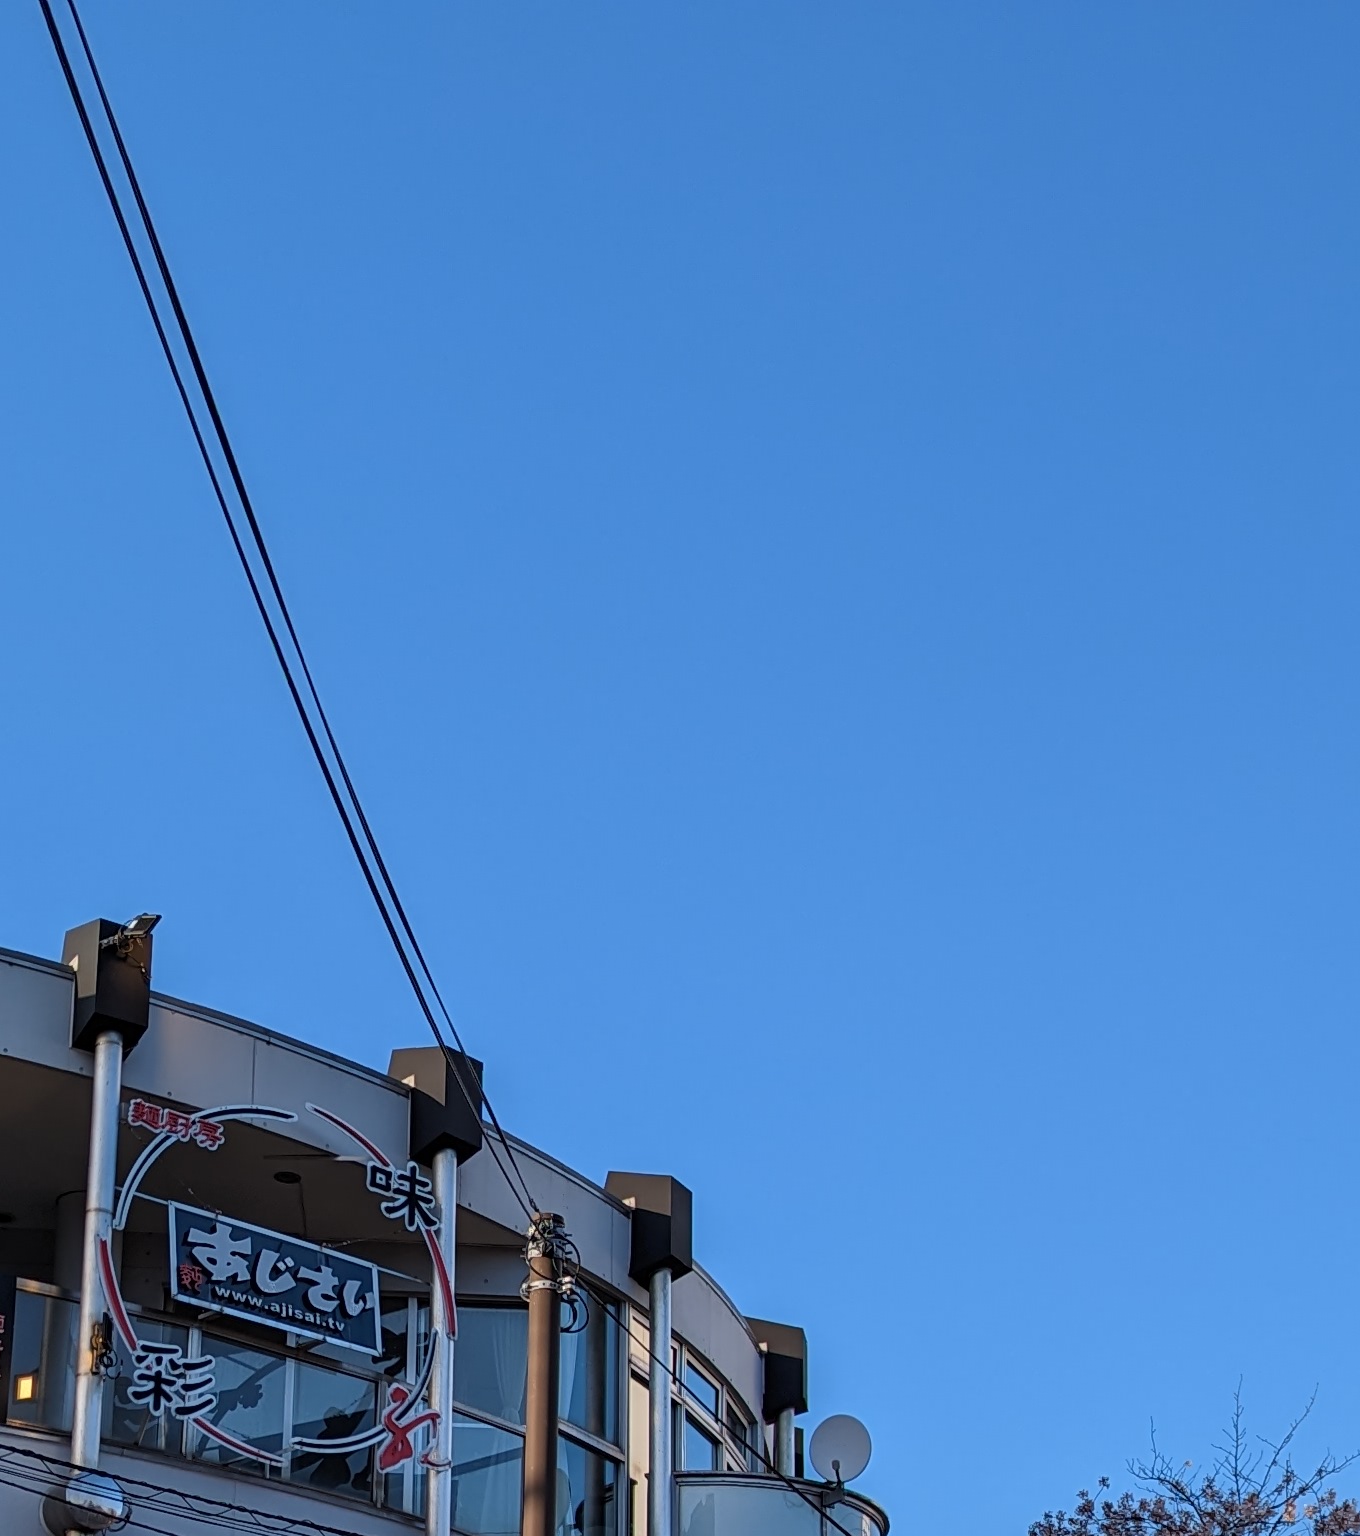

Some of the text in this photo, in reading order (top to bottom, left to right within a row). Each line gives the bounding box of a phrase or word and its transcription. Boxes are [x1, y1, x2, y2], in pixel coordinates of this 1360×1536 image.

[128, 1098, 225, 1151] 麺厨房
[366, 1160, 440, 1232] 味
[184, 1221, 375, 1319] あじさい
[215, 1284, 346, 1333] www.ajisai.tv
[127, 1340, 218, 1418] 彩
